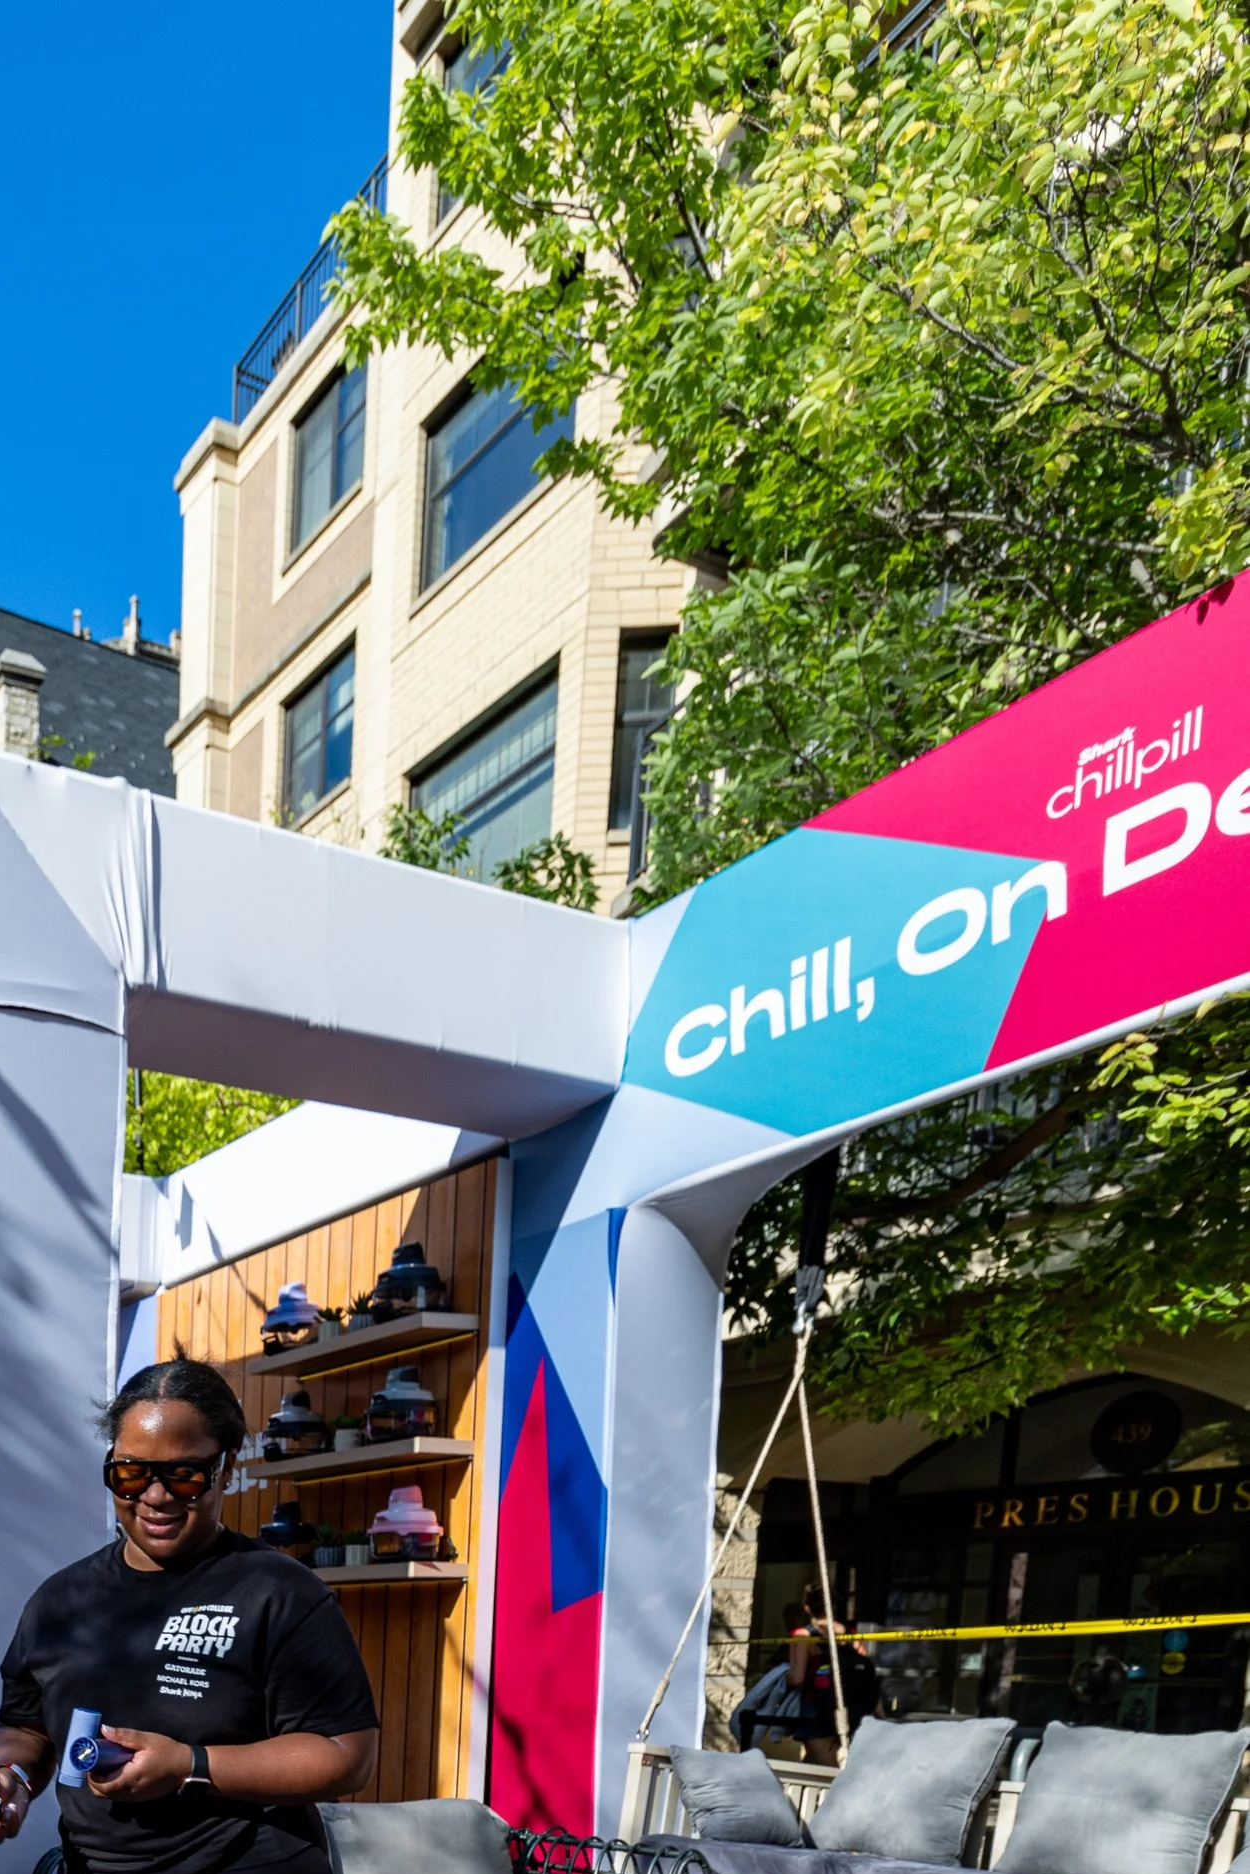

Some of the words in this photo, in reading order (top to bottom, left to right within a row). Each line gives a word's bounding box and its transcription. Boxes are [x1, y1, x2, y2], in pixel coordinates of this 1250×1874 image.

[1077, 726, 1137, 766] Shark
[1046, 704, 1204, 819] chillpill
[664, 935, 876, 1077] Chill,
[897, 860, 1068, 977] On
[1112, 1421, 1152, 1444] 439
[973, 1492, 1089, 1529] PRES
[1109, 1479, 1250, 1520] HOUS
[206, 1604, 234, 1614] COLLEGE
[162, 1613, 240, 1637] BLOCK
[154, 1633, 234, 1658] PARTY
[156, 1674, 188, 1685] MICHAEL
[189, 1679, 210, 1688] KORS
[164, 1663, 206, 1676] GATORADE
